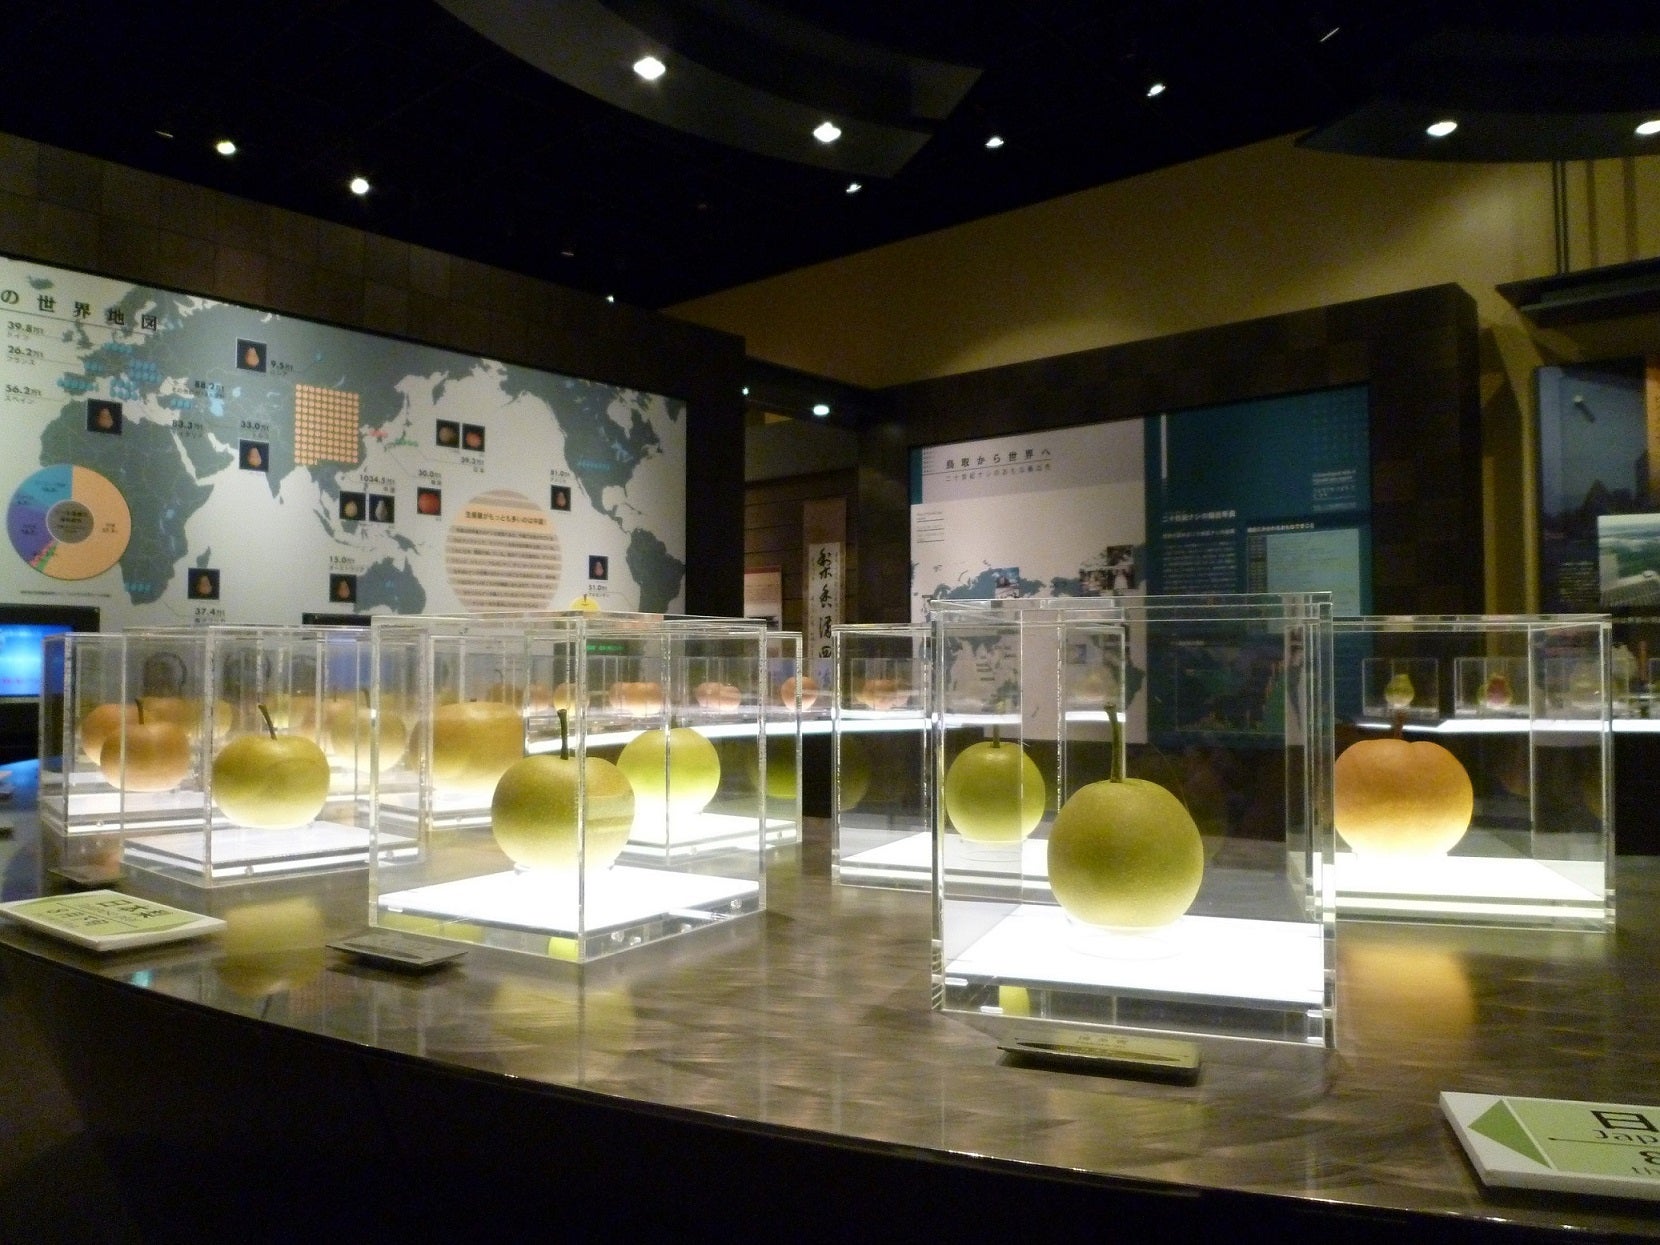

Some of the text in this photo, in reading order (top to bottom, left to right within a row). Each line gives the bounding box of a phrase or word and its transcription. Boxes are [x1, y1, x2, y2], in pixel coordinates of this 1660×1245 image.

[1, 289, 157, 331] の世界地図
[945, 448, 1051, 470] 鳥取から世界へ
